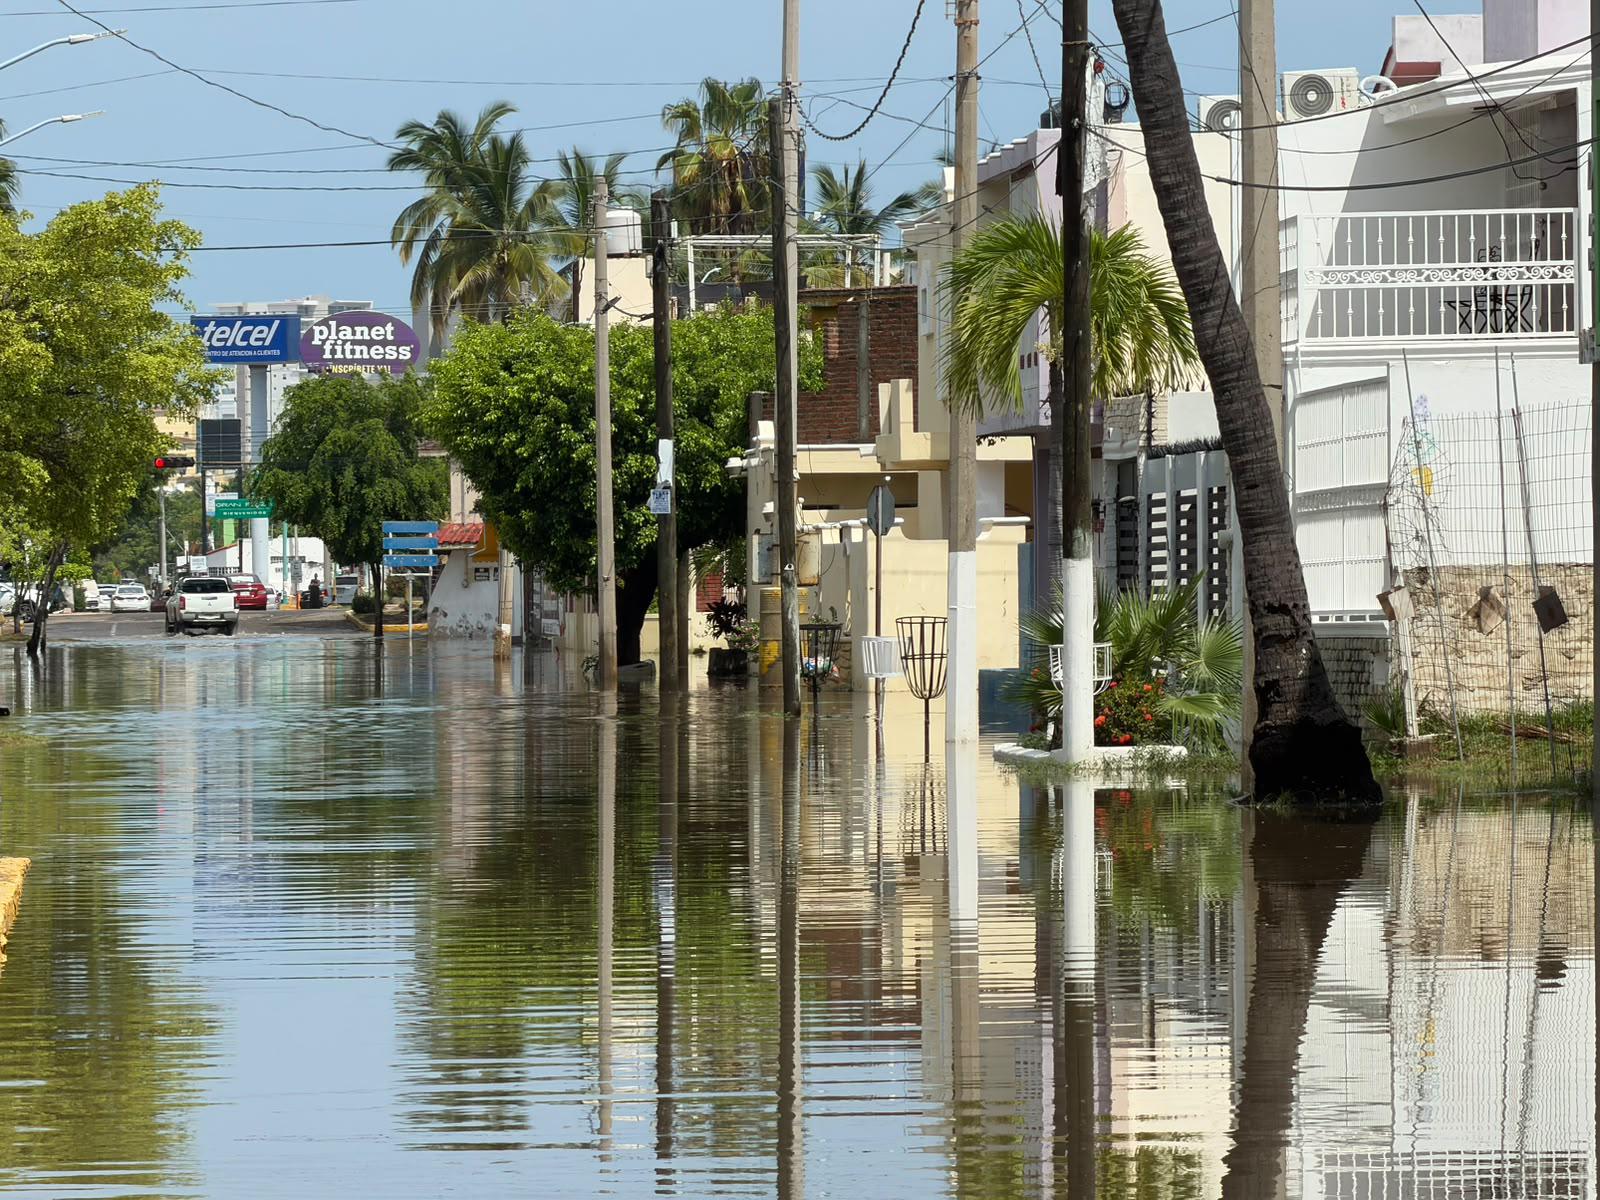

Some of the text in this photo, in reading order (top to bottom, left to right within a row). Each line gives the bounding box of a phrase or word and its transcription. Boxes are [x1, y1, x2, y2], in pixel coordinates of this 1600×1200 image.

[202, 319, 280, 346] telcel
[311, 320, 395, 345] planet
[322, 339, 412, 360] fitness
